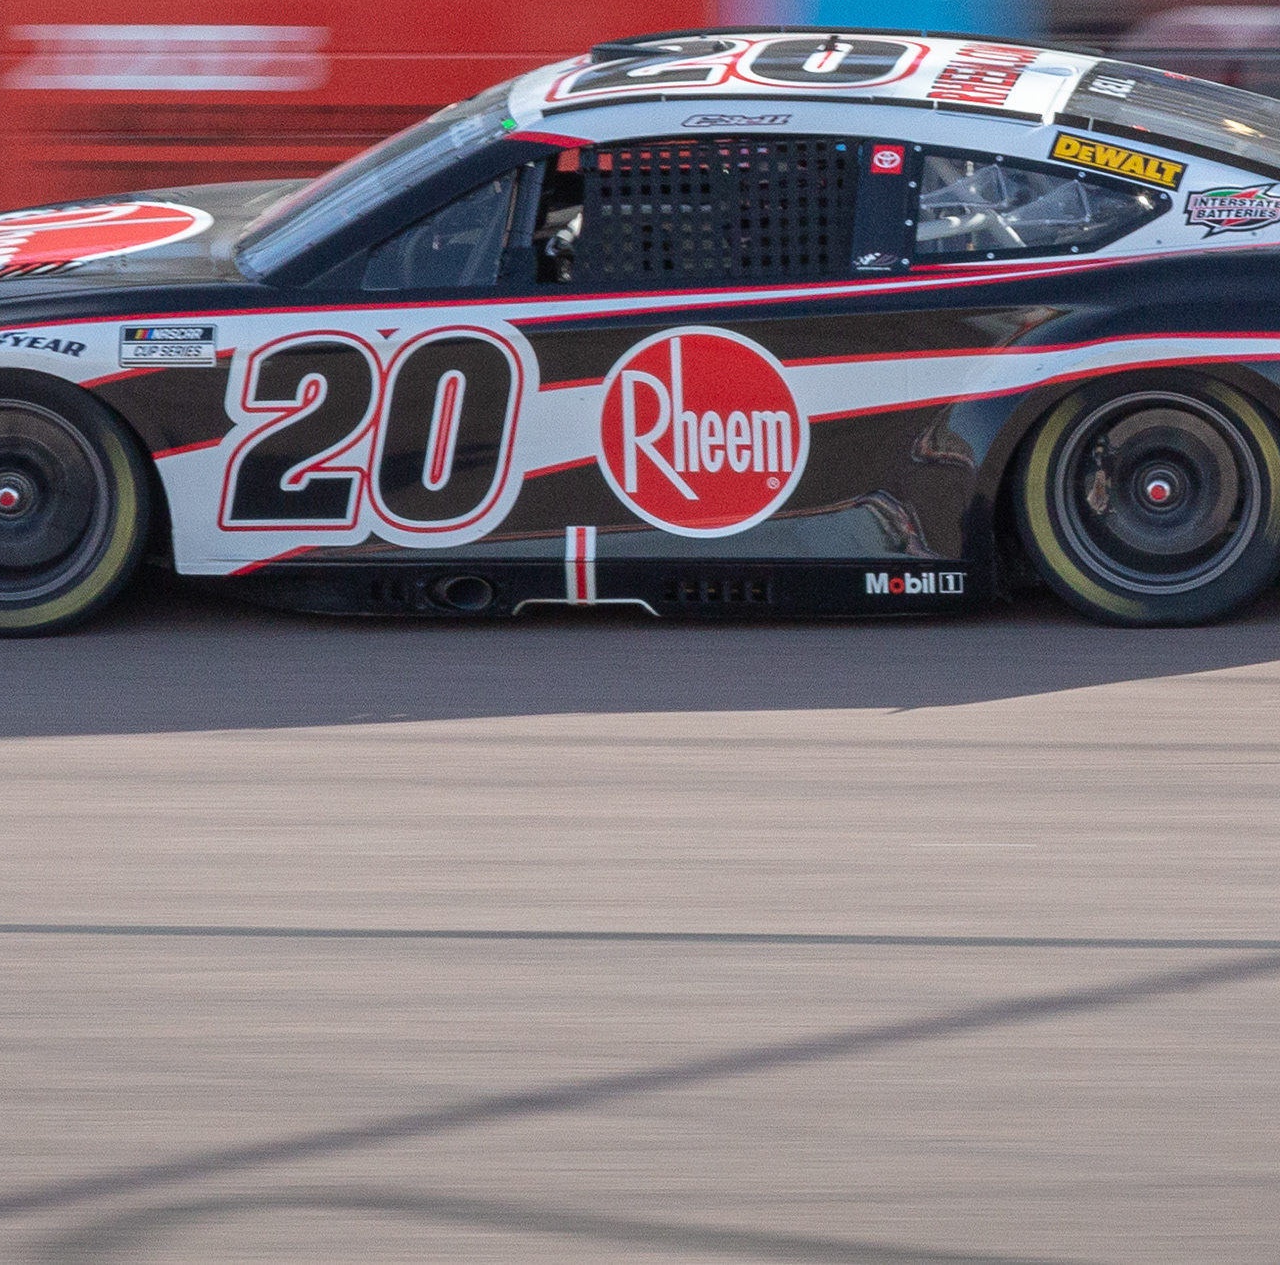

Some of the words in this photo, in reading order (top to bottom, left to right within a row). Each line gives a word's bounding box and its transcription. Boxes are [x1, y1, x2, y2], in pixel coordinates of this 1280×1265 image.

[547, 36, 928, 101] 20
[1196, 208, 1277, 219] BATTERIES
[153, 328, 204, 340] NASCAR
[134, 345, 159, 357] CUP
[160, 345, 203, 357] SERIES
[219, 324, 523, 533] 20
[620, 336, 793, 501] Rheem
[865, 572, 936, 595] Mobil
